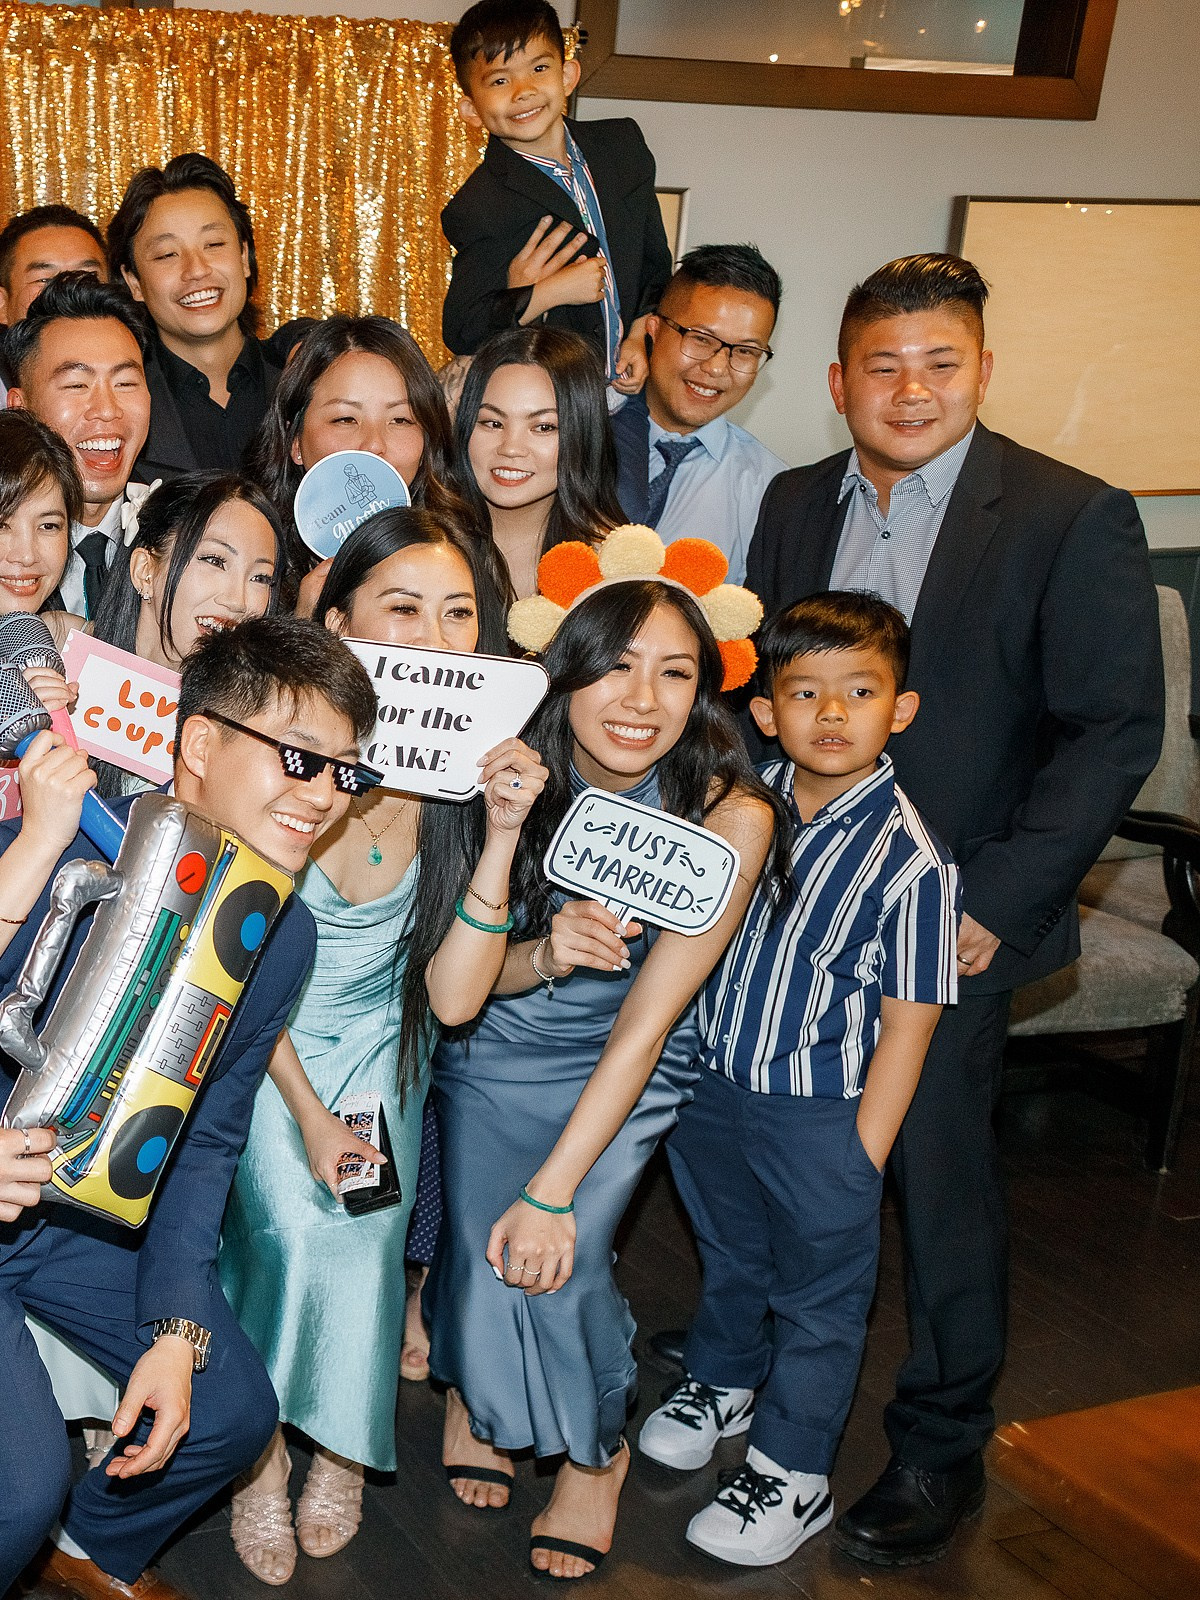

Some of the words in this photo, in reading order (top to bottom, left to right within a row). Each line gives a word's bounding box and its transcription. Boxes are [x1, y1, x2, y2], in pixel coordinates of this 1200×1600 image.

[313, 503, 347, 529] Team
[374, 655, 388, 679] I
[391, 662, 485, 690] came
[118, 679, 179, 719] Lov
[377, 695, 415, 725] or
[420, 707, 473, 732] the
[367, 742, 451, 773] CAKE
[610, 821, 687, 866] JUST
[575, 847, 694, 911] MARRIED
